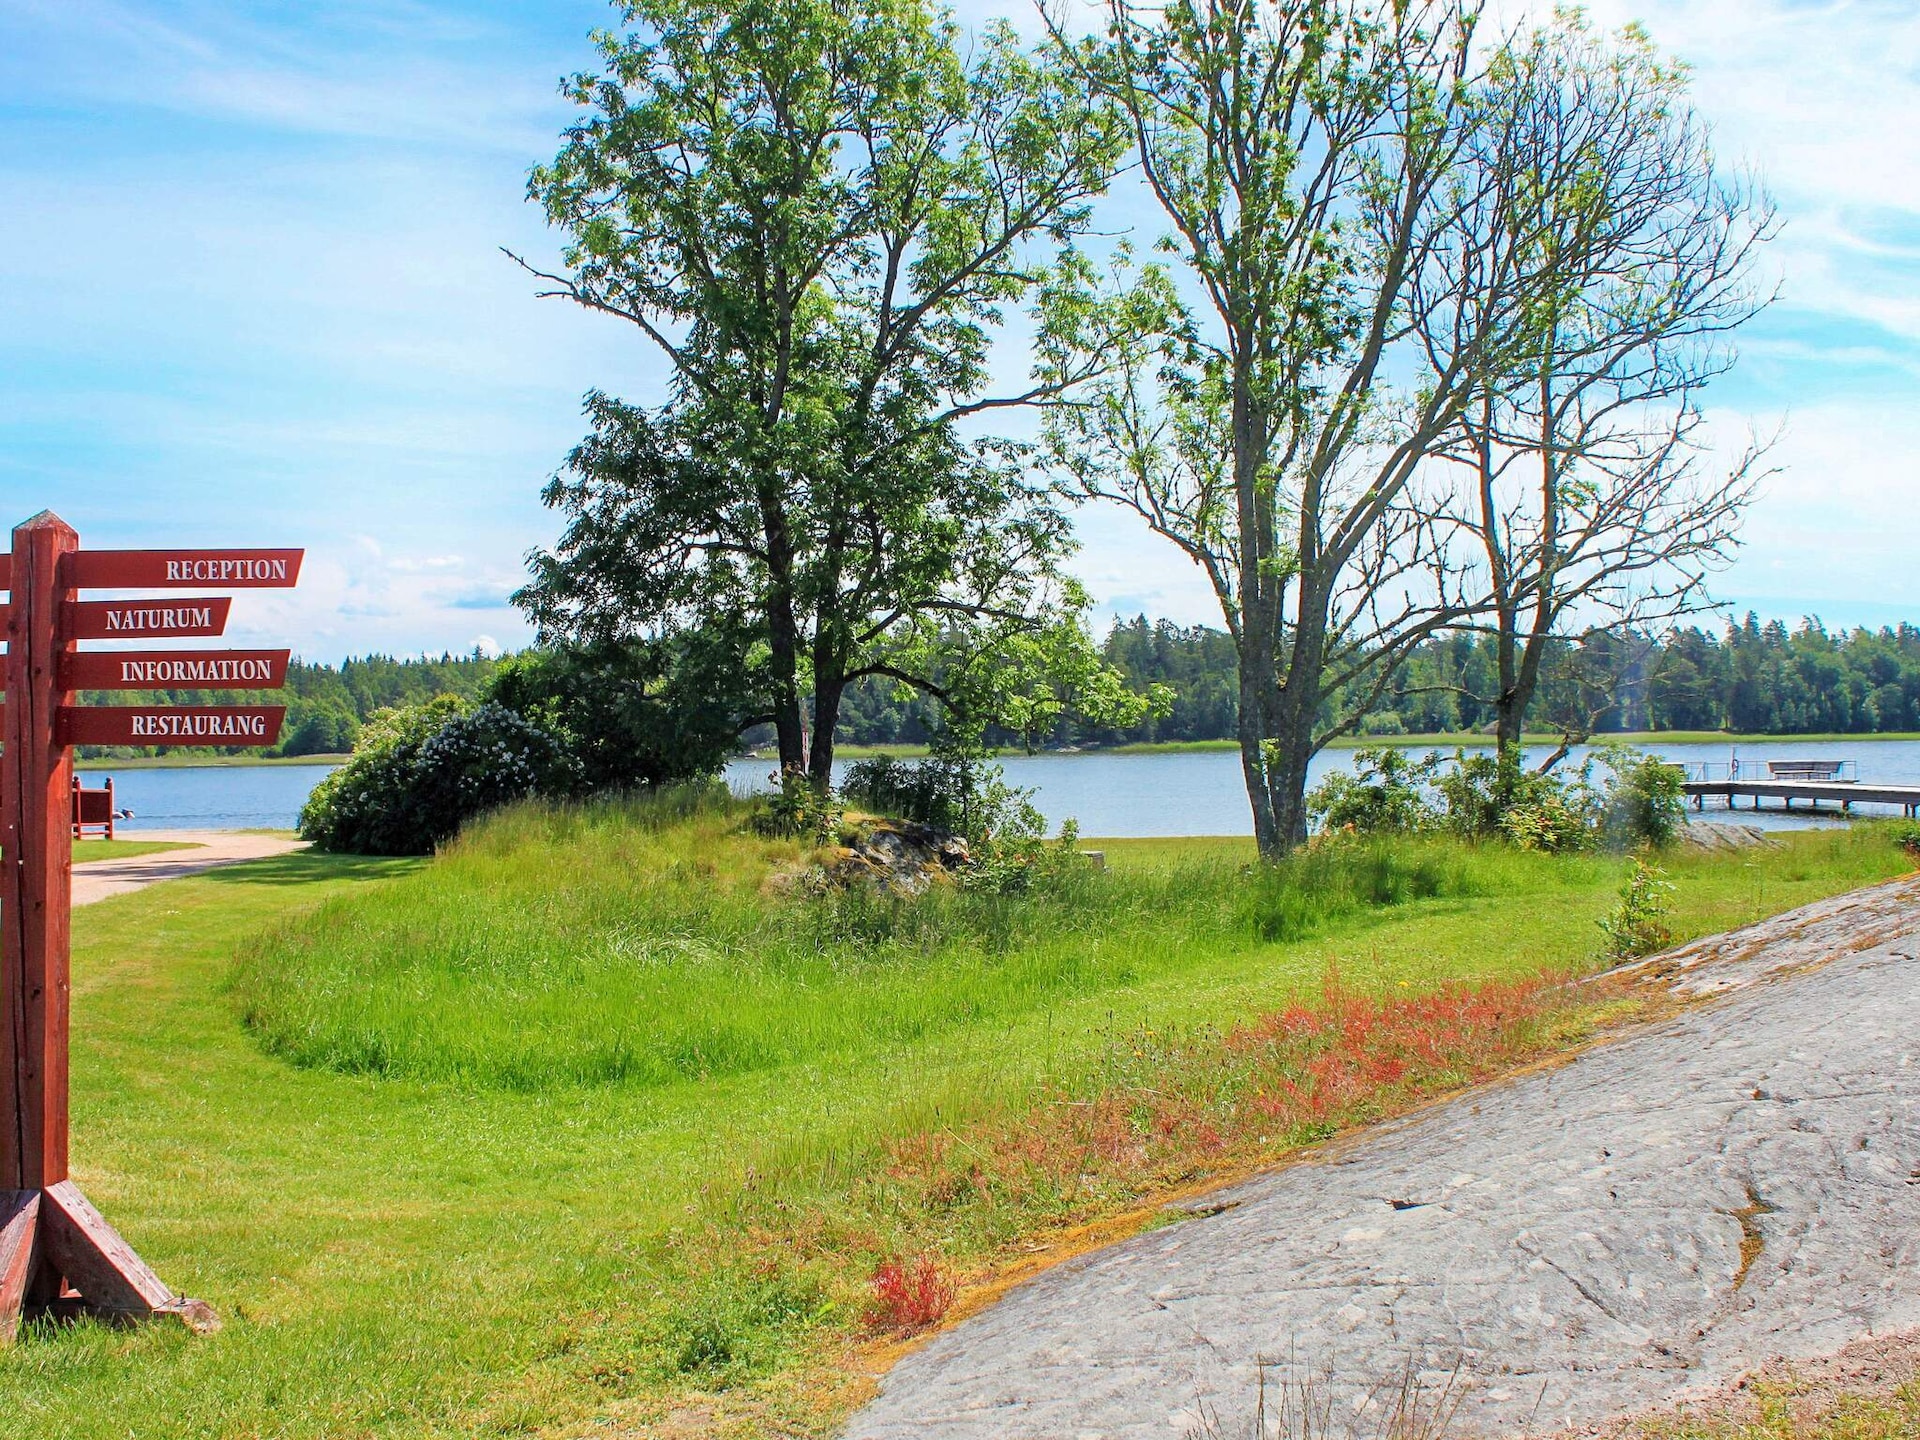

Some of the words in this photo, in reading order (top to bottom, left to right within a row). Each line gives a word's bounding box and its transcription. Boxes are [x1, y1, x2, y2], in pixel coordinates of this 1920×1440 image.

[166, 559, 287, 581] RECEPTION
[105, 607, 212, 630] NATURUM
[121, 659, 272, 682] INFORMATION
[131, 715, 266, 736] RESTAURANG
